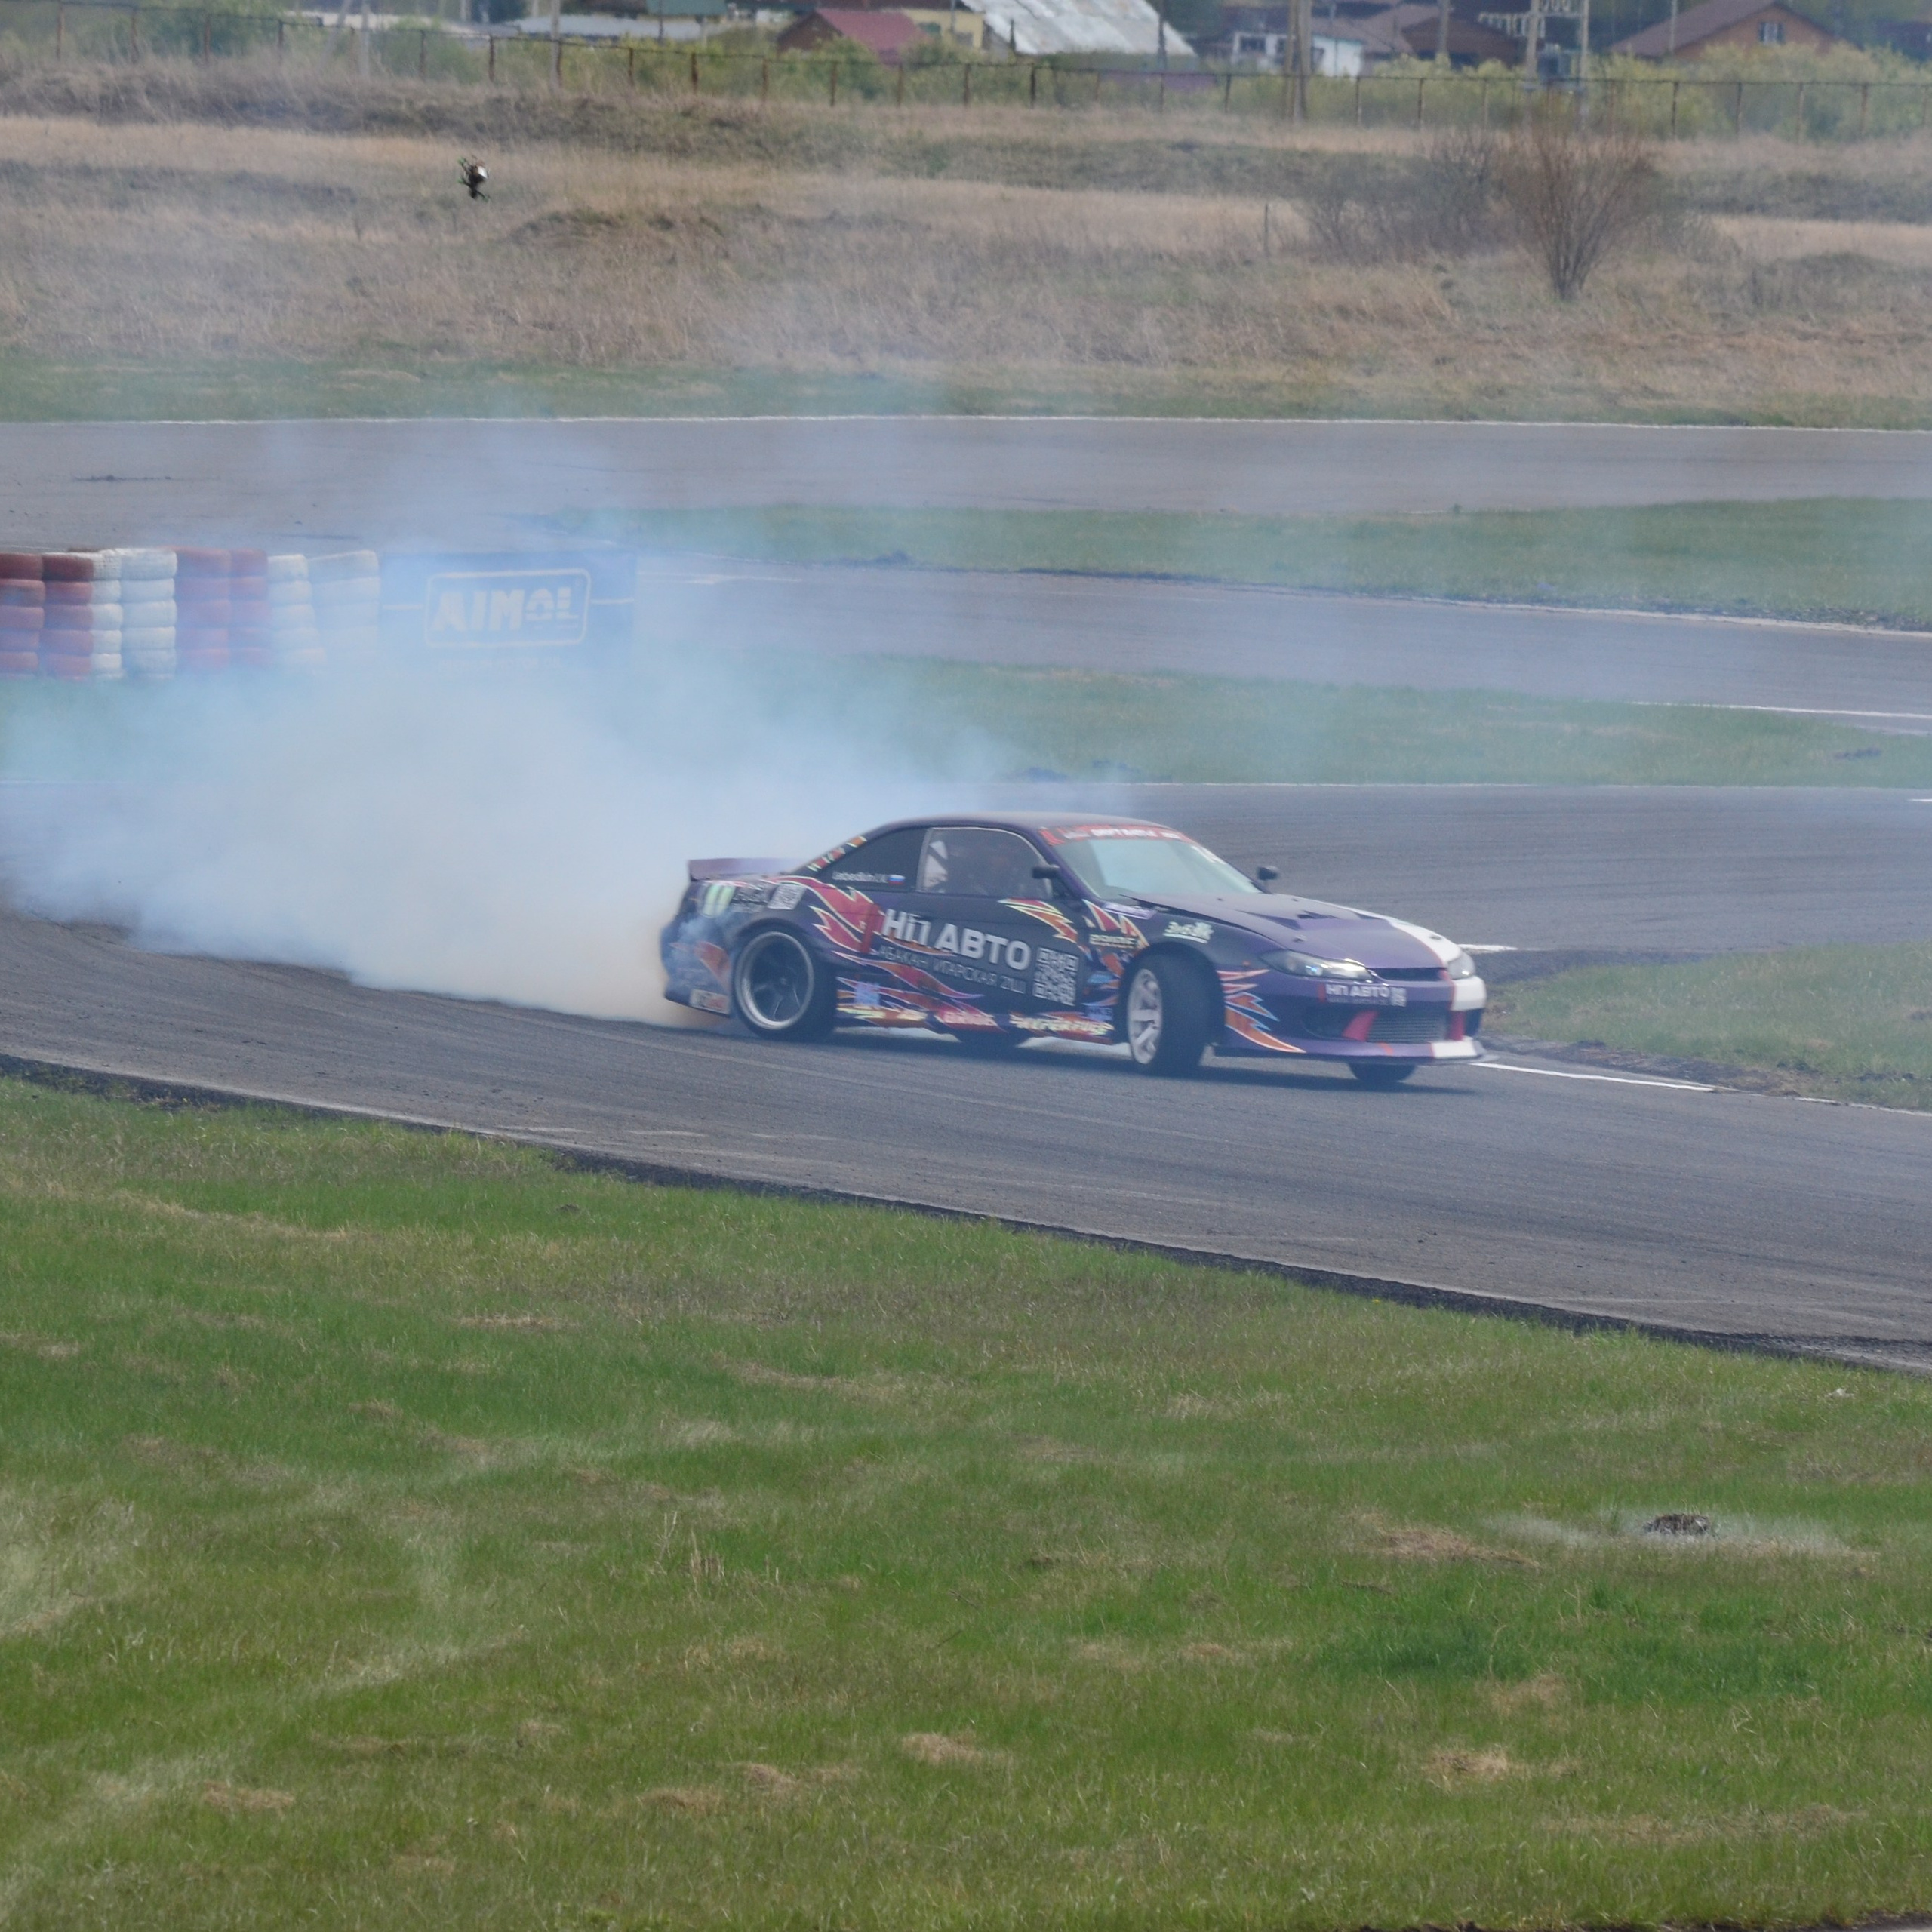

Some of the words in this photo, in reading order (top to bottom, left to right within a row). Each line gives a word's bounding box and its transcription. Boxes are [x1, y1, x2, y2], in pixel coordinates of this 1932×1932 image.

[431, 586, 580, 632] AIMOL
[934, 923, 1031, 971] АВТО
[1349, 985, 1390, 998] АВТО
